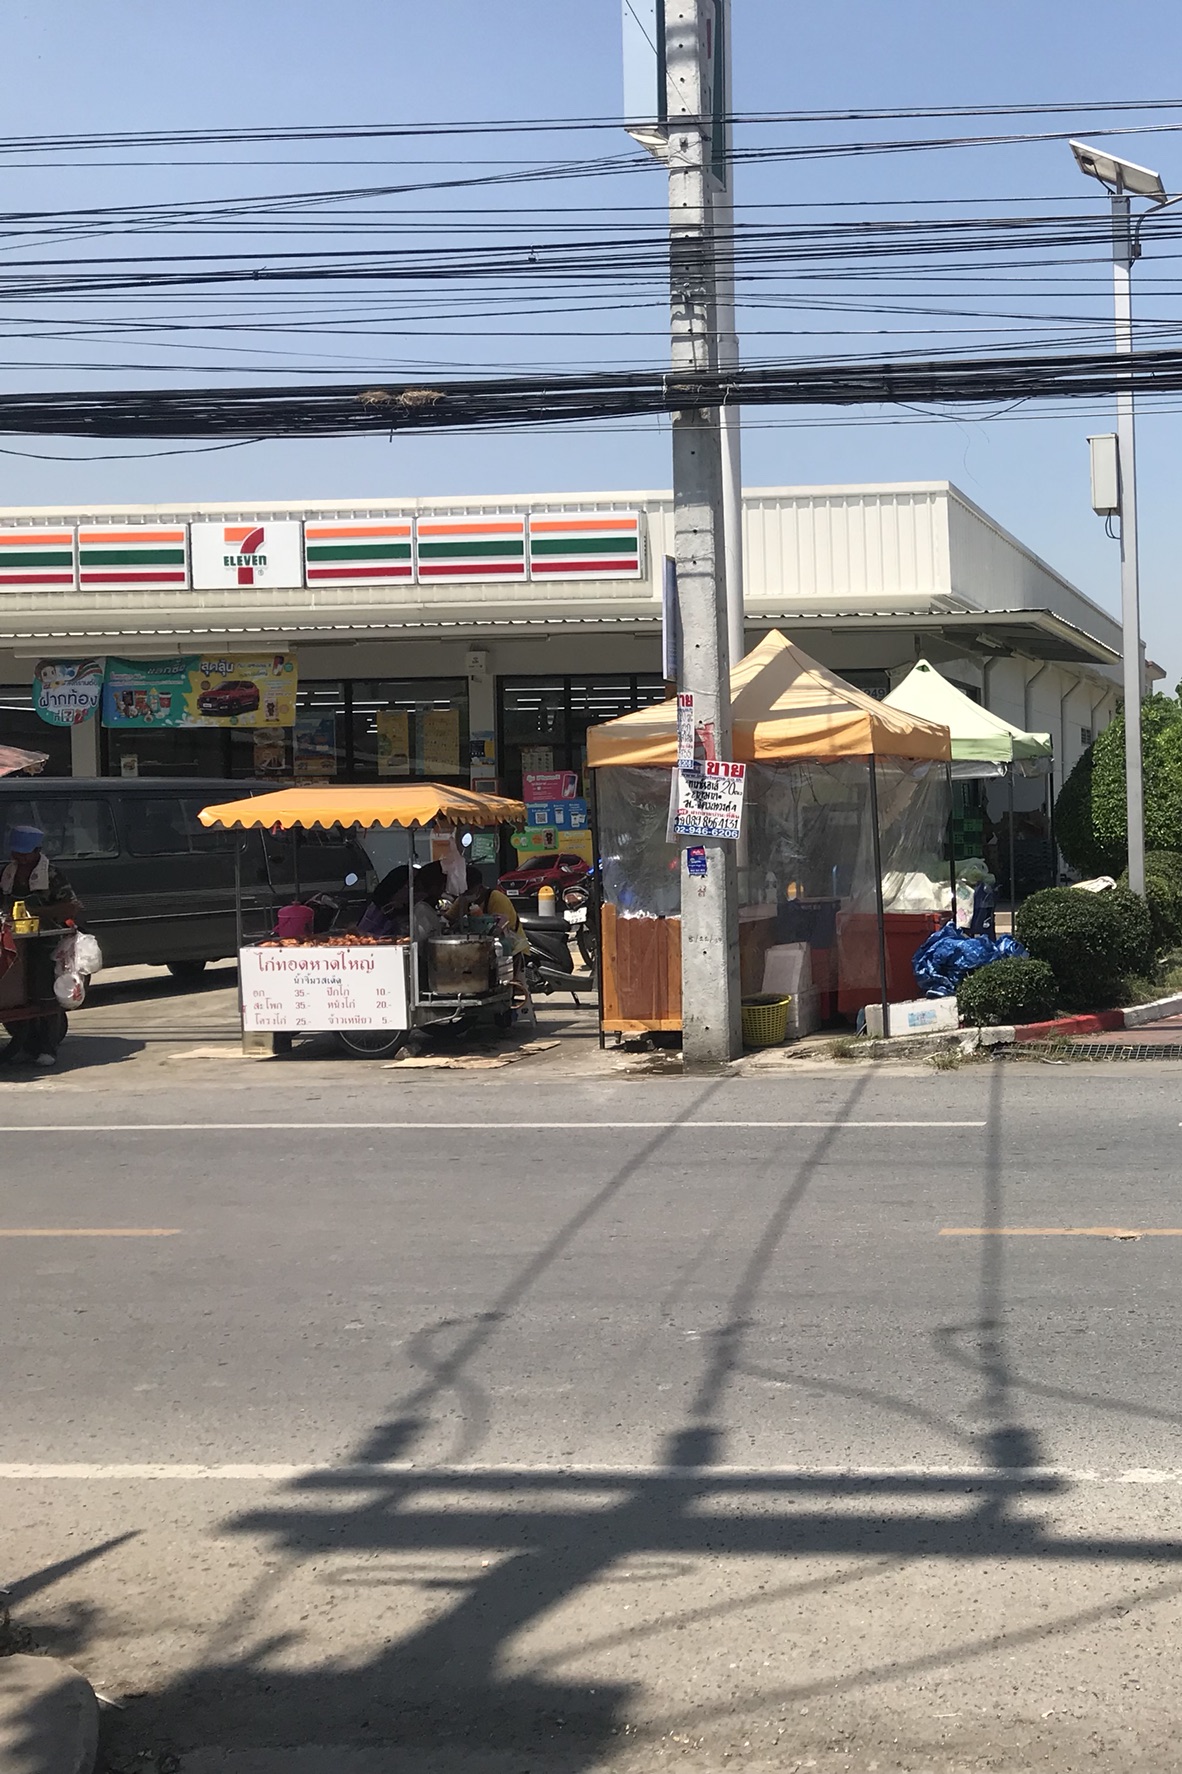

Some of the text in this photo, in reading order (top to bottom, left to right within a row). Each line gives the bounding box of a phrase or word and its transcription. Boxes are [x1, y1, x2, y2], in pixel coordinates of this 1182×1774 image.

[223, 527, 265, 585] 7
[200, 659, 234, 677] สุดลุ้น
[39, 689, 98, 707] ฝากท้อง
[706, 760, 745, 779] ขาย
[674, 826, 739, 839] 02-946-6206
[254, 951, 375, 974] ไก่ทอดหาดใหญ่
[293, 973, 342, 985] น้ำจิ้มรสเด็ด
[253, 989, 265, 998] อก
[326, 984, 350, 997] ปีกไก่
[253, 998, 283, 1010] สะโพก
[327, 997, 356, 1010] หนังไก่
